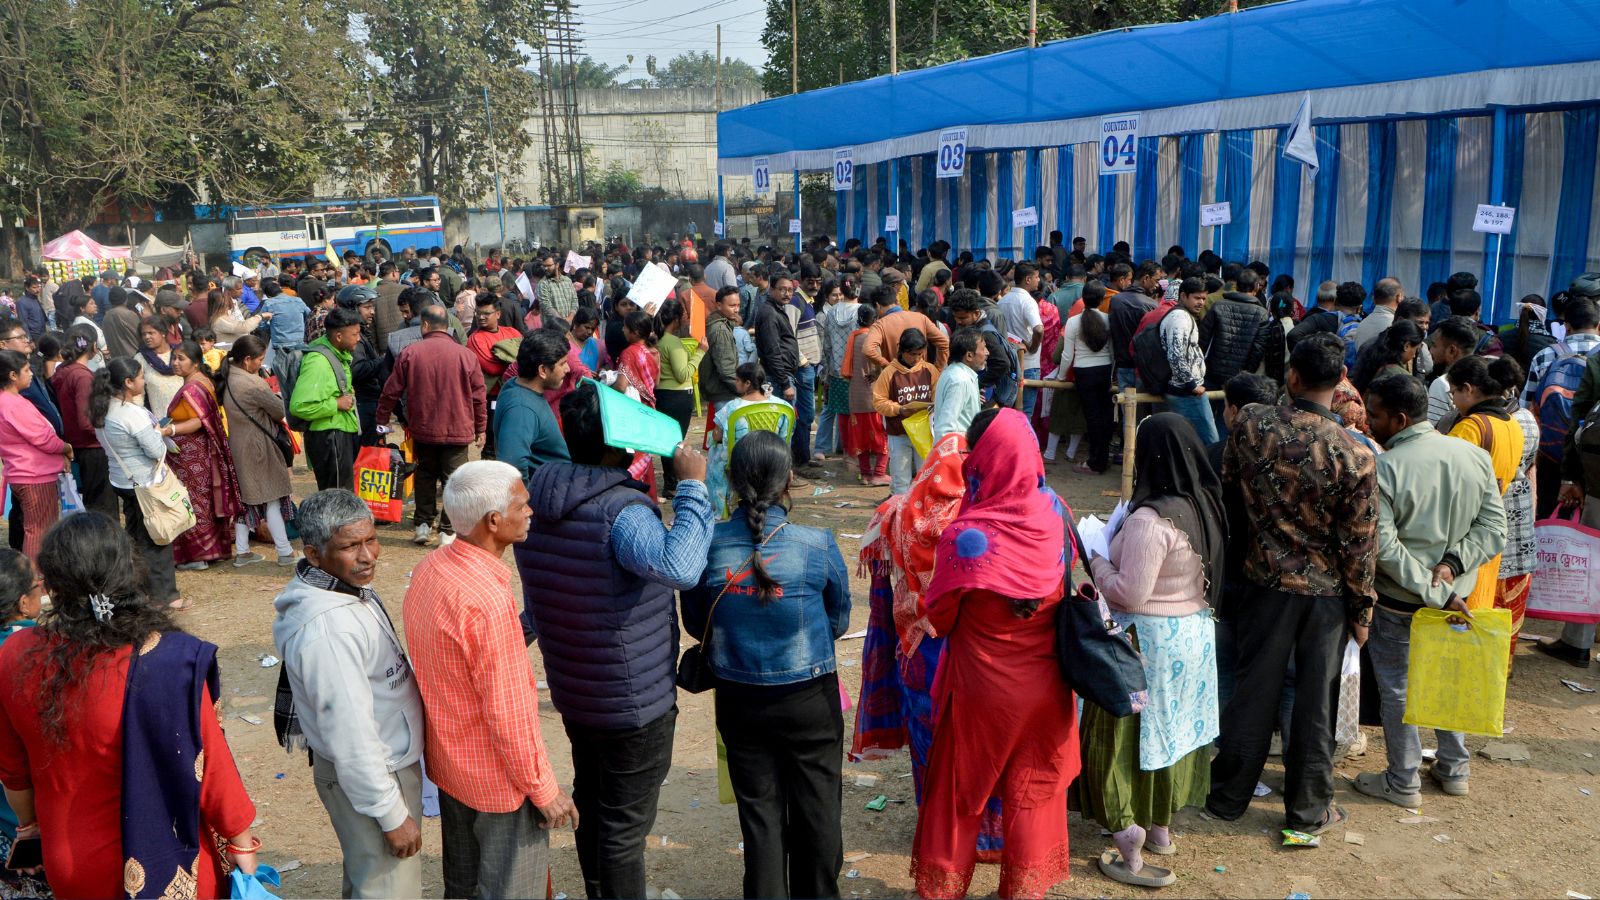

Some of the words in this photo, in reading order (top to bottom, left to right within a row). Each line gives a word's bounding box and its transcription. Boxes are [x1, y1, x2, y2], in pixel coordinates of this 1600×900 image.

[1103, 121, 1127, 133] COUNTER
[1129, 120, 1137, 130] NO
[941, 143, 965, 170] 03
[1103, 134, 1136, 167] 04
[757, 167, 770, 188] 01
[836, 160, 852, 184] 02
[898, 385, 915, 395] HOW
[361, 470, 390, 485] CITI
